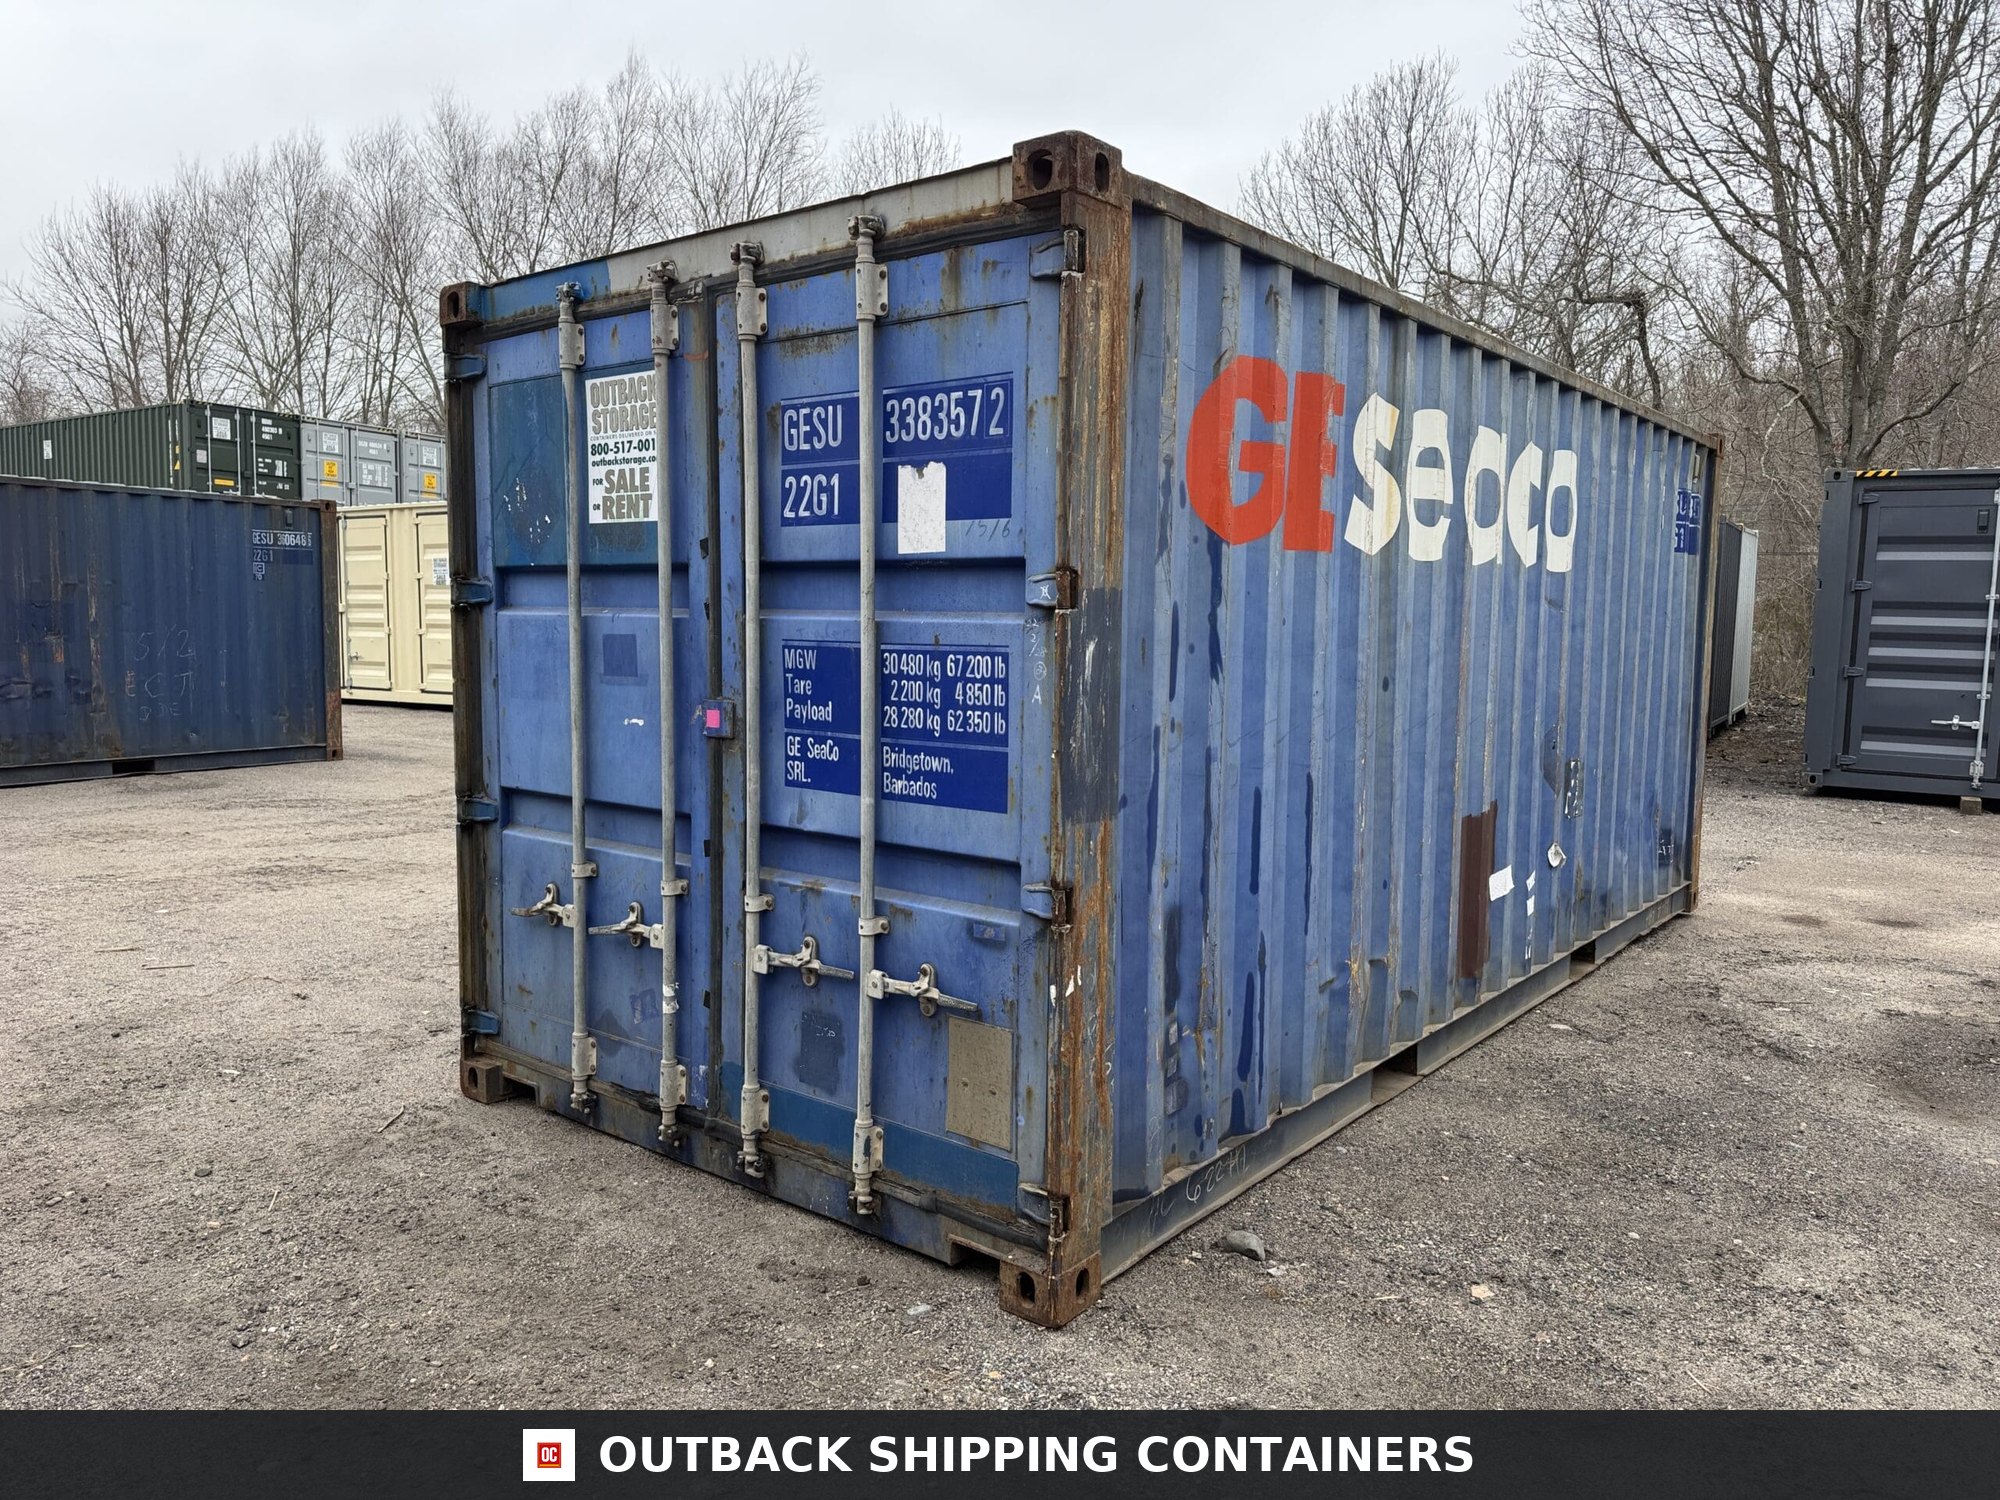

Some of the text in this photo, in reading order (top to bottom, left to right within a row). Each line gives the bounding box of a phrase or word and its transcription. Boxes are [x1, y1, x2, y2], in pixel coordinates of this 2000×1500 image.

[591, 402, 656, 435] STORAGE
[783, 404, 843, 451] GESU
[592, 467, 650, 494] FOR SALE
[783, 473, 840, 518] 22G1
[592, 493, 652, 520] OR RENT
[252, 532, 274, 545] GESU
[784, 648, 817, 670] MGW
[926, 654, 941, 682] kg
[994, 656, 1006, 680] lb
[785, 673, 812, 695] Tare
[926, 681, 941, 709] kg
[994, 684, 1006, 708] lb
[786, 700, 833, 724] Payload
[926, 708, 941, 737] kg
[994, 712, 1006, 735] lb
[786, 736, 839, 762] GE SeaCo
[787, 761, 812, 783] SRL.
[883, 771, 937, 800] Barbados
